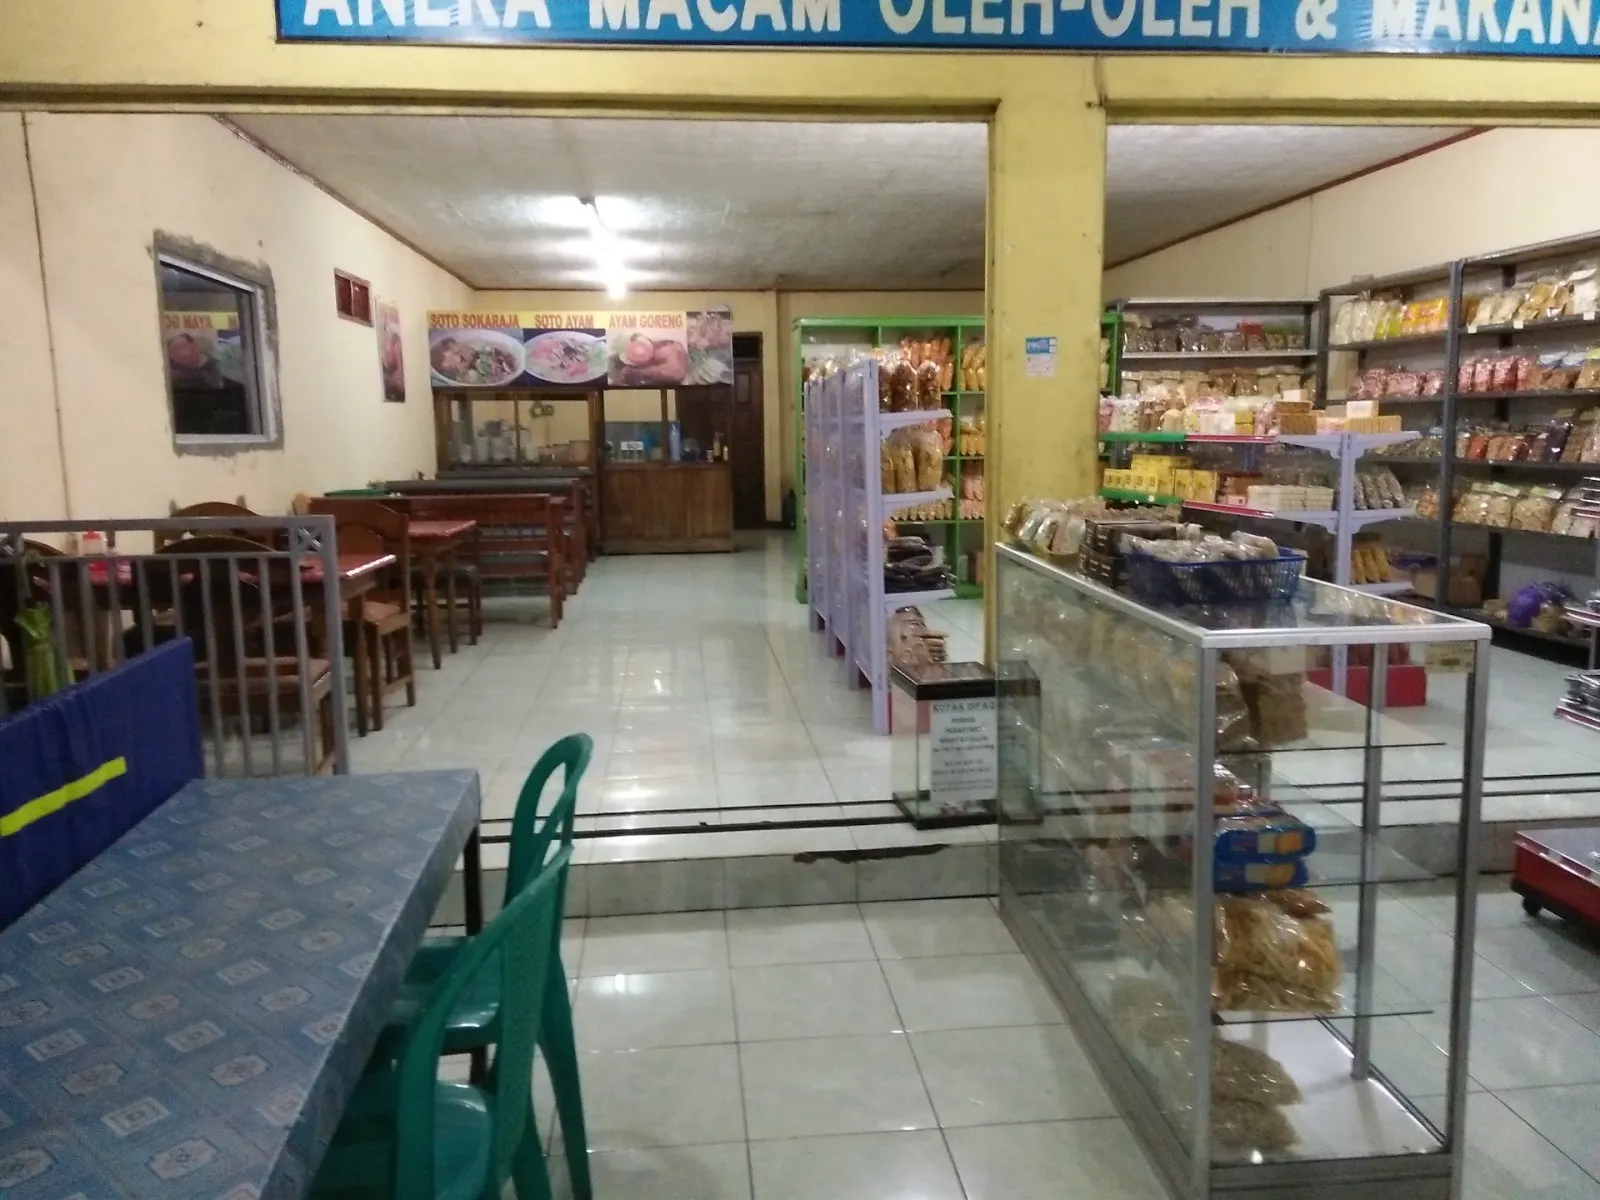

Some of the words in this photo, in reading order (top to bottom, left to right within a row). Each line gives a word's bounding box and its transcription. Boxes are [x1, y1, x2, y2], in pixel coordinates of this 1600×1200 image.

[589, 0, 841, 33] MACAM
[879, 0, 1260, 37] OLEH-OLEH
[1295, 0, 1337, 41] &
[1371, 0, 1600, 45] MAKAN
[430, 313, 459, 328] SOTO
[462, 313, 520, 328] SOKARAJA
[534, 314, 562, 328] SOTO
[565, 314, 594, 328] AYAM
[608, 314, 637, 328] AYAM
[639, 314, 683, 329] GORENG
